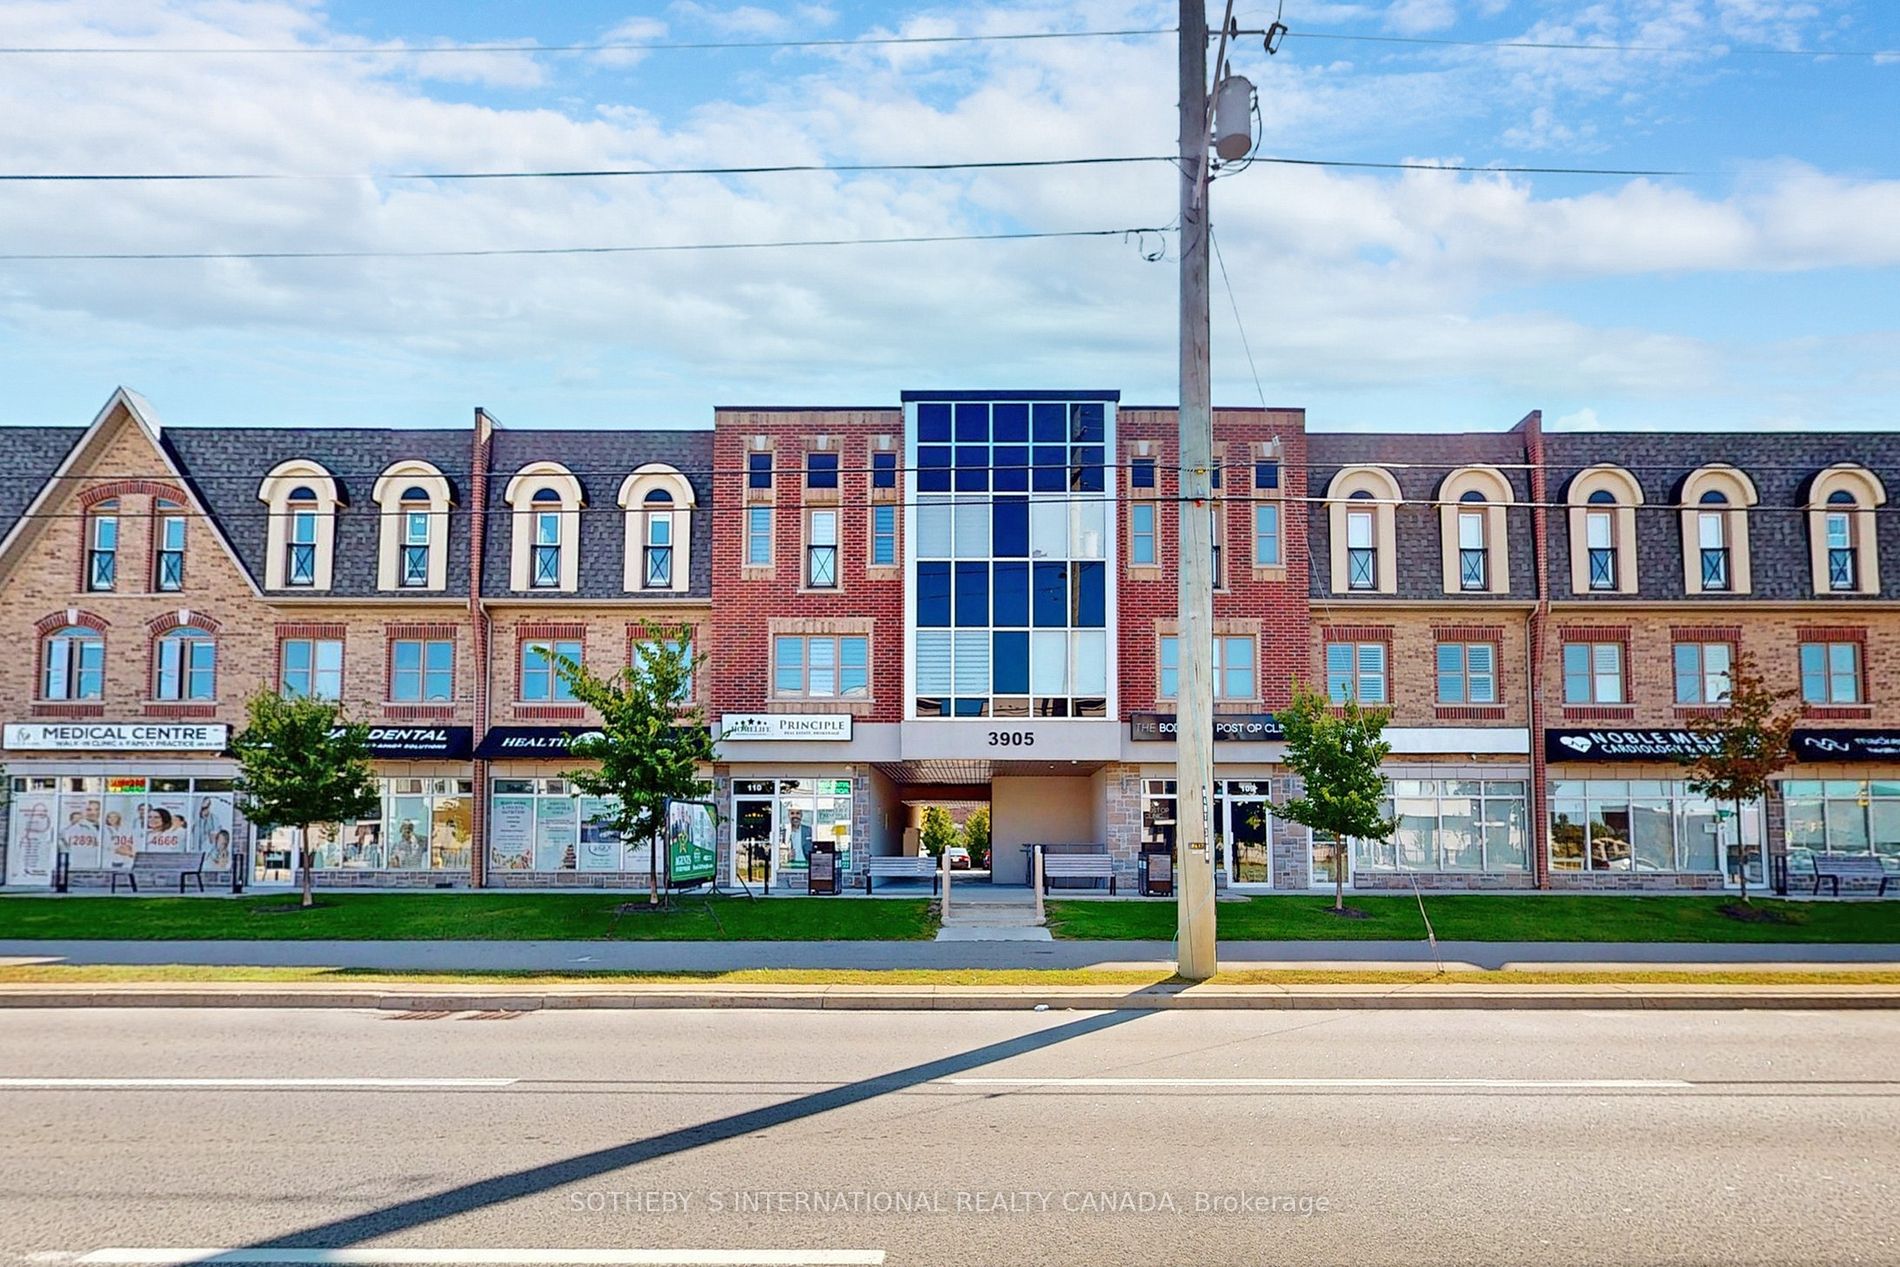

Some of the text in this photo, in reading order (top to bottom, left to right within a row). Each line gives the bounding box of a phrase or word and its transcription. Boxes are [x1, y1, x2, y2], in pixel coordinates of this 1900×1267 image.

[779, 720, 845, 730] PRINCIPLE
[1135, 723, 1156, 732] THE
[1217, 723, 1244, 733] POST
[1247, 723, 1262, 733] OP
[43, 727, 207, 739] MEDICAL CENTRE
[368, 729, 447, 740] DENTAL
[1589, 732, 1667, 744] NOBLE
[988, 732, 1035, 746] 3905
[1601, 745, 1682, 754] CARDIOLOGY
